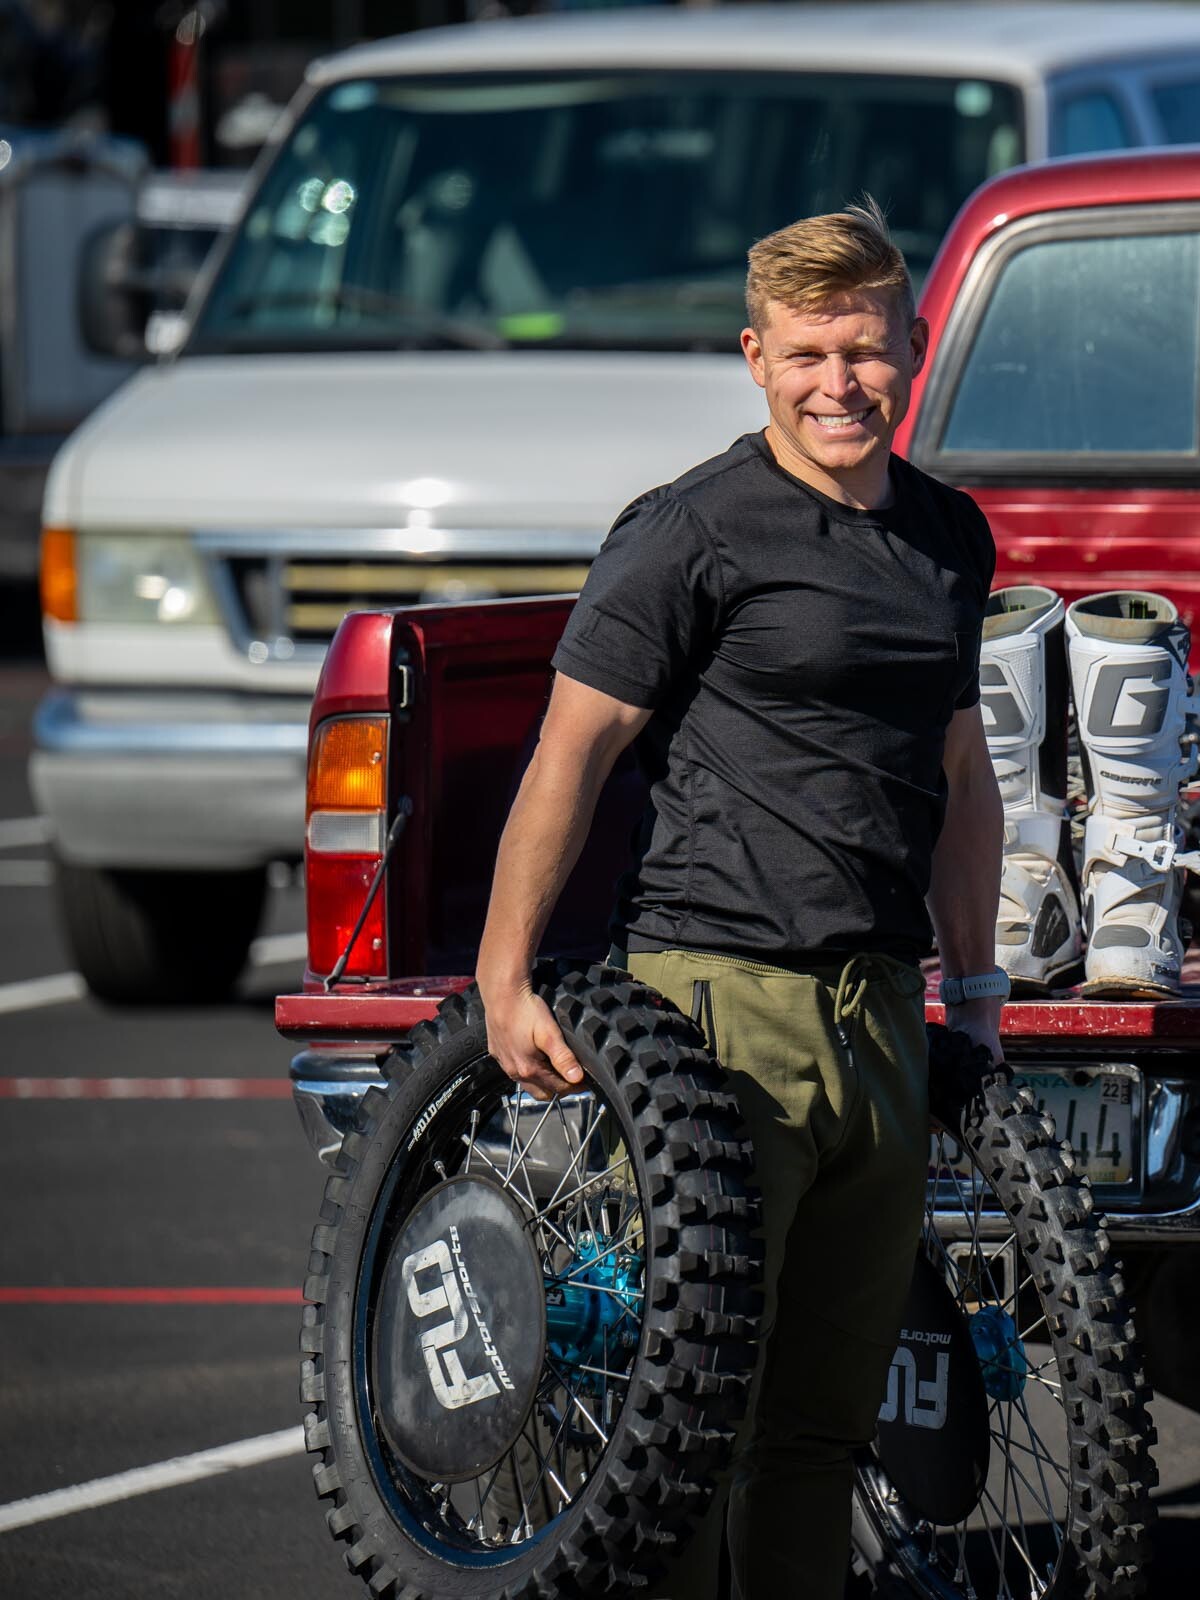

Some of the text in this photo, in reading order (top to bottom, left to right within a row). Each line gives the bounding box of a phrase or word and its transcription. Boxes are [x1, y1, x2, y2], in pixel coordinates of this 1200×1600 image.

[1102, 1083, 1119, 1098] 22
[401, 1240, 501, 1409] FLO
[449, 1225, 515, 1390] motorsports
